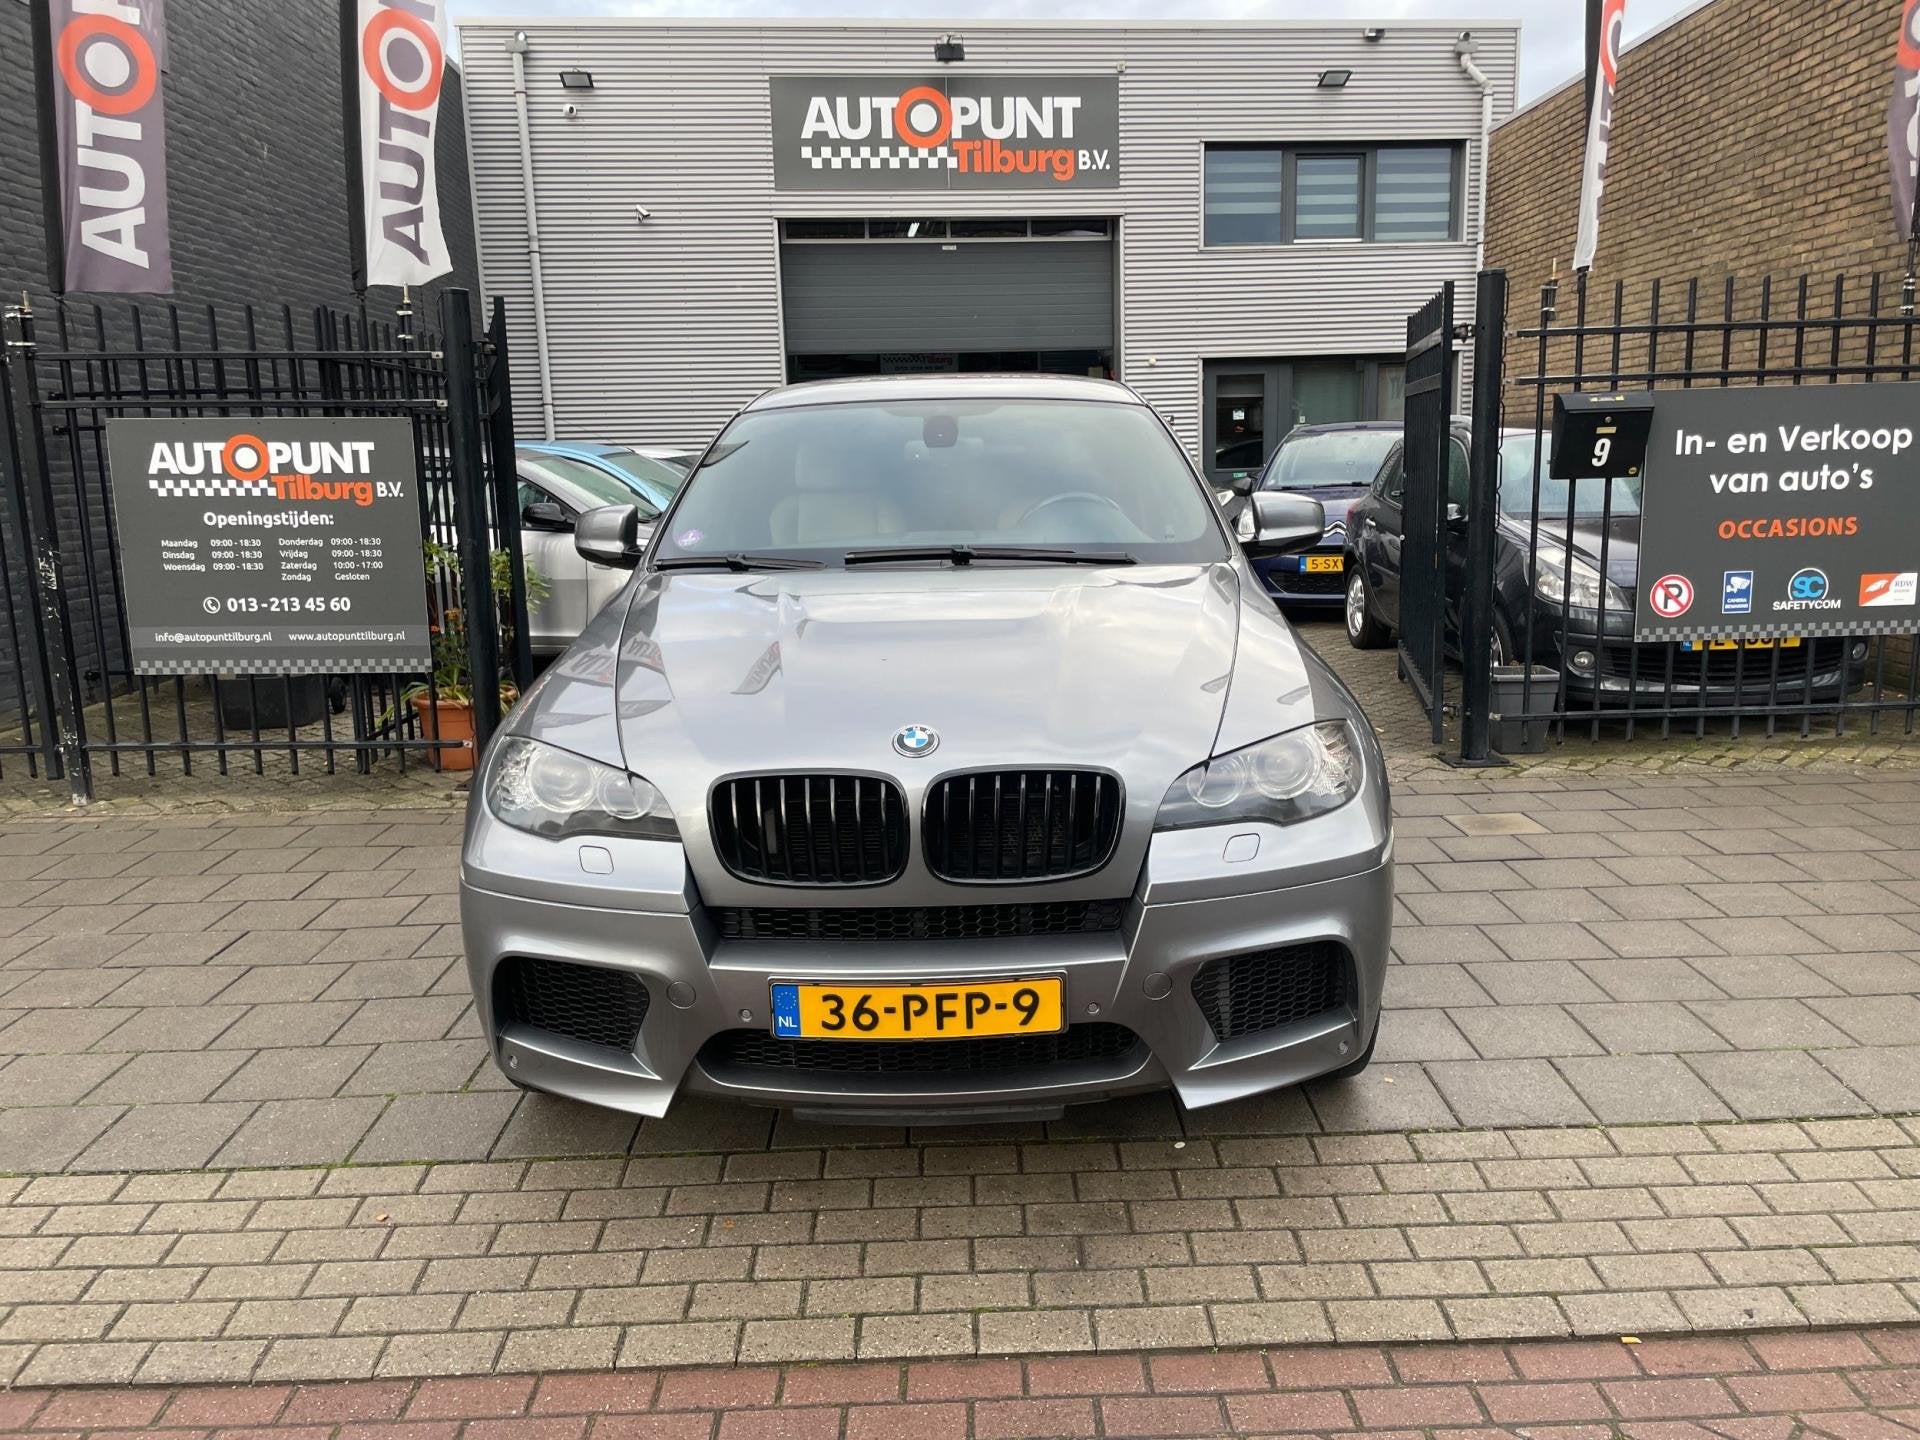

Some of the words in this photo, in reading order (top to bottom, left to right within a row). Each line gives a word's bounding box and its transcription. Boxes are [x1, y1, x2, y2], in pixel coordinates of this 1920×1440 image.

[801, 86, 1081, 149] AUTOPUNT
[952, 139, 1075, 181] Tilburg
[1078, 149, 1111, 170] B.V.
[1675, 429, 1716, 456] In-
[1727, 432, 1767, 454] en
[1778, 423, 1913, 455] Verkoop
[148, 433, 375, 482] AUTOPUNT
[1592, 438, 1611, 467] 9
[1709, 472, 1769, 494] van
[1778, 463, 1873, 492] auto's
[271, 474, 374, 506] Tilburg
[376, 481, 404, 498] B.V.
[203, 510, 335, 529] Openingstijden:
[1718, 515, 1858, 540] OCCASIONS
[161, 538, 198, 549] Maandag
[210, 539, 233, 547] 09:00
[239, 539, 262, 547] 18:30
[278, 537, 324, 548] Donderdag
[330, 537, 353, 546] 09:00
[359, 537, 382, 546] 18:30
[162, 550, 195, 561] Dinsdag
[211, 550, 234, 559] 09:00
[240, 550, 263, 559] 18:30
[279, 549, 309, 560] Vrijdag
[331, 549, 354, 558] 09:00
[360, 549, 383, 558] 18:30
[163, 562, 206, 573] Woensdag
[212, 562, 236, 571] 09:00
[241, 562, 264, 571] 18:30
[280, 561, 318, 571] Zaterdag
[333, 561, 355, 570] 10:00
[361, 561, 384, 570] 17:00
[281, 572, 312, 583] Zondag
[334, 572, 370, 581] Gesloten
[304, 597, 326, 612] 45
[329, 597, 351, 611] 60
[1772, 600, 1842, 611] SAFETYCOM
[154, 631, 273, 644] info@autopunttilburg.nl
[288, 630, 406, 643] www.autopunttilburg.nl
[820, 987, 1041, 1032] 36-PFP-9
[778, 1015, 798, 1028] NL
